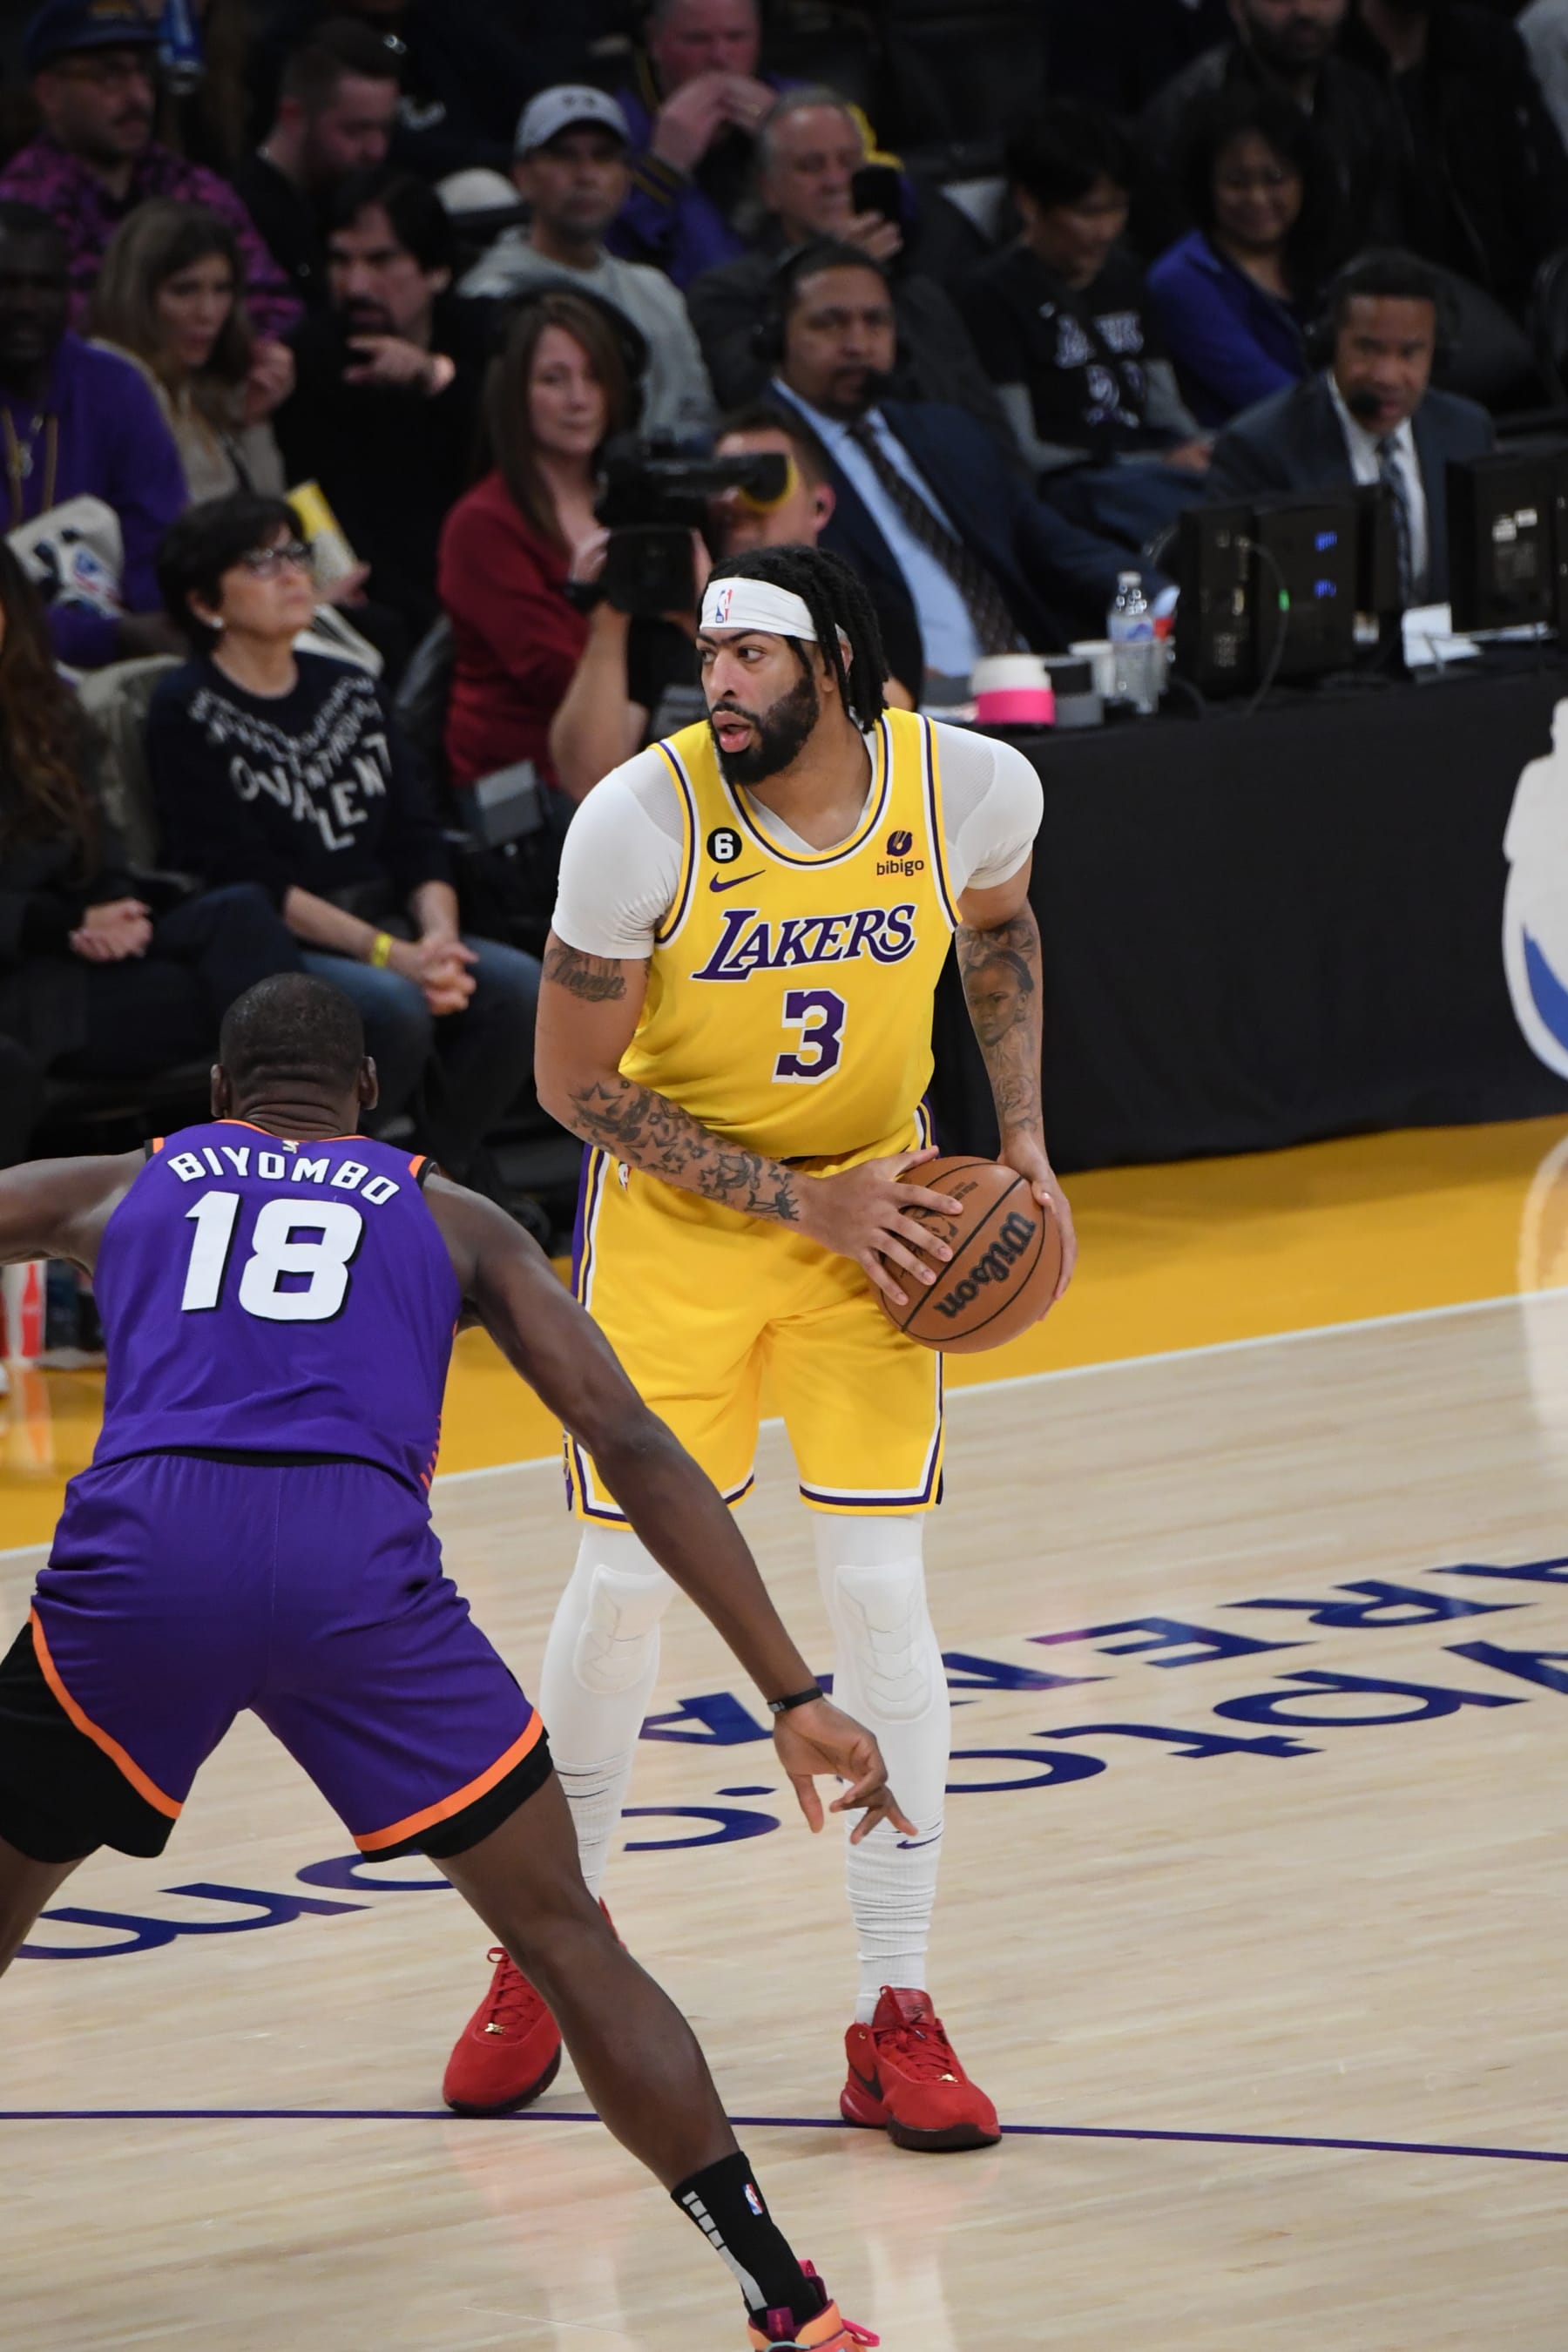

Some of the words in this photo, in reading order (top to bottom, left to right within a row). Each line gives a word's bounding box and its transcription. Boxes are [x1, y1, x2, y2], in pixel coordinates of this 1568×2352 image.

[714, 832, 734, 860] 6
[876, 858, 925, 877] bibigo
[687, 902, 919, 982] LAKERS
[772, 987, 848, 1085] 3
[166, 1146, 402, 1206] BIYOMBO
[180, 1190, 366, 1323] 18
[933, 1211, 1037, 1318] Wilson
